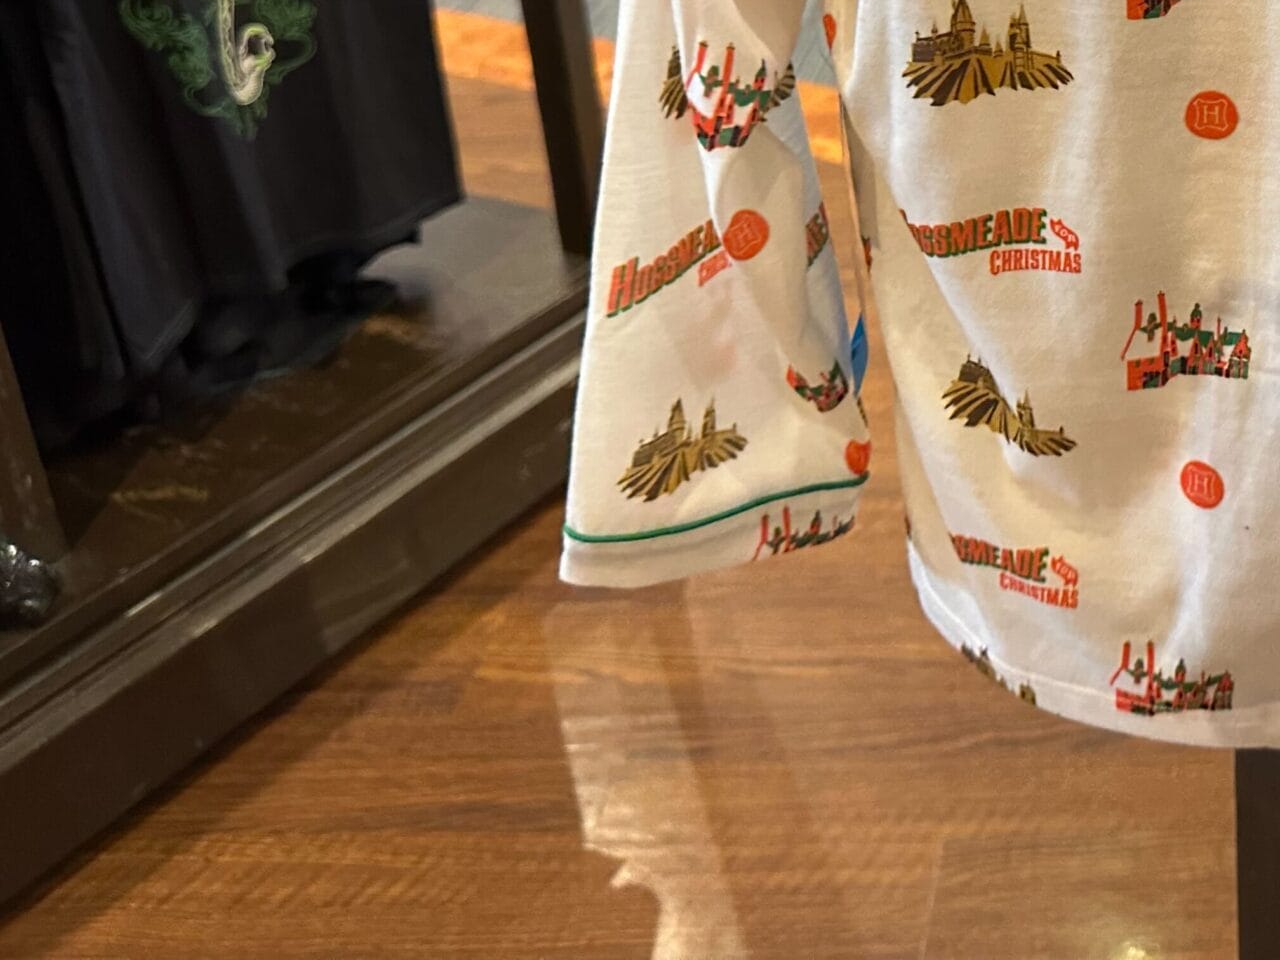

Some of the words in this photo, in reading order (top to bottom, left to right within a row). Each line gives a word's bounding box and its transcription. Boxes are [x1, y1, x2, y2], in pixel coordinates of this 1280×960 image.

[899, 207, 1048, 259] GSMEADE
[606, 218, 722, 319] HOGSMEA
[989, 249, 1082, 277] CHRISTMAS
[949, 531, 1050, 583] SMEADE
[999, 571, 1078, 610] CHRISTMAS
